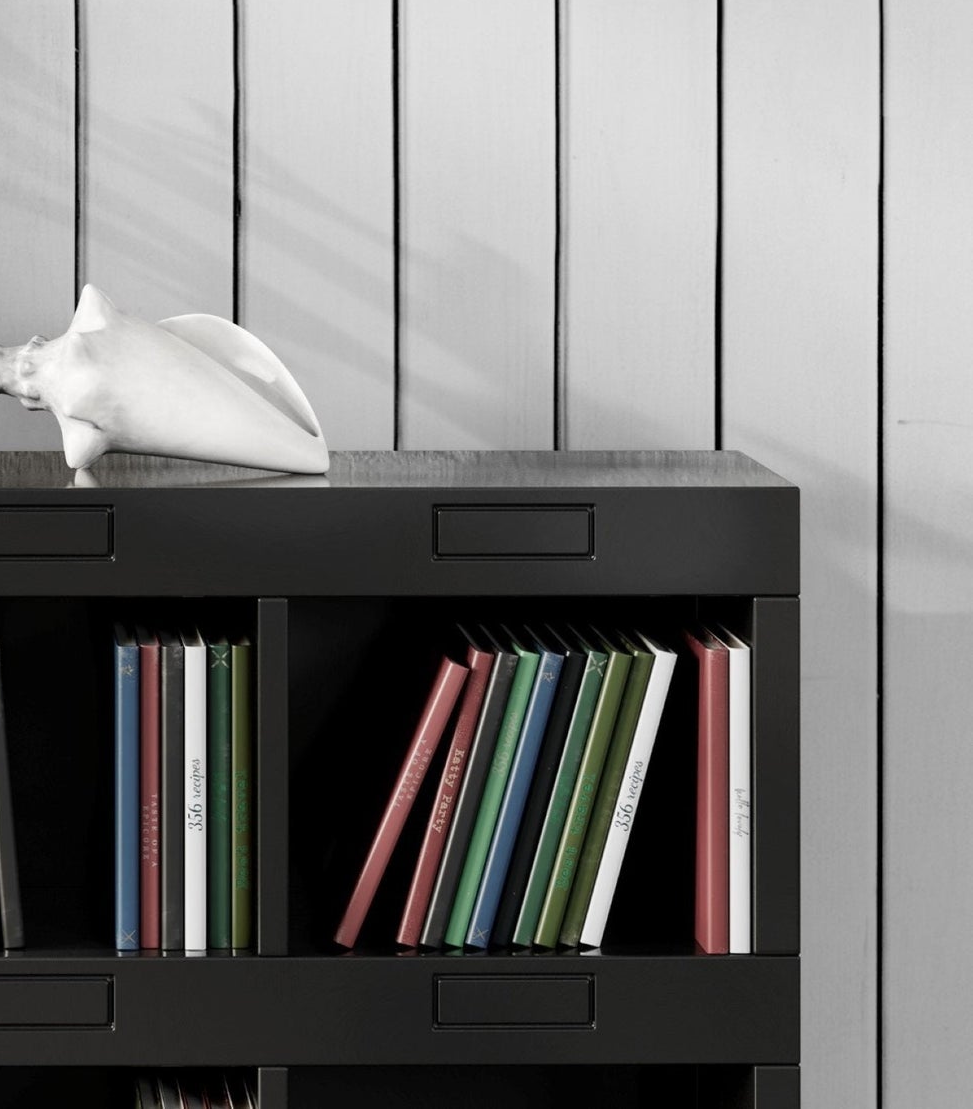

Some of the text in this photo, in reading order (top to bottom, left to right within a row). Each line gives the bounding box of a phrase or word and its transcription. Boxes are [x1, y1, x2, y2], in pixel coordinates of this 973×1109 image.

[187, 758, 205, 832] 356 recipes
[432, 748, 466, 834] Katty Party
[614, 760, 644, 832] 356 recipes
[151, 839, 158, 855] OF
